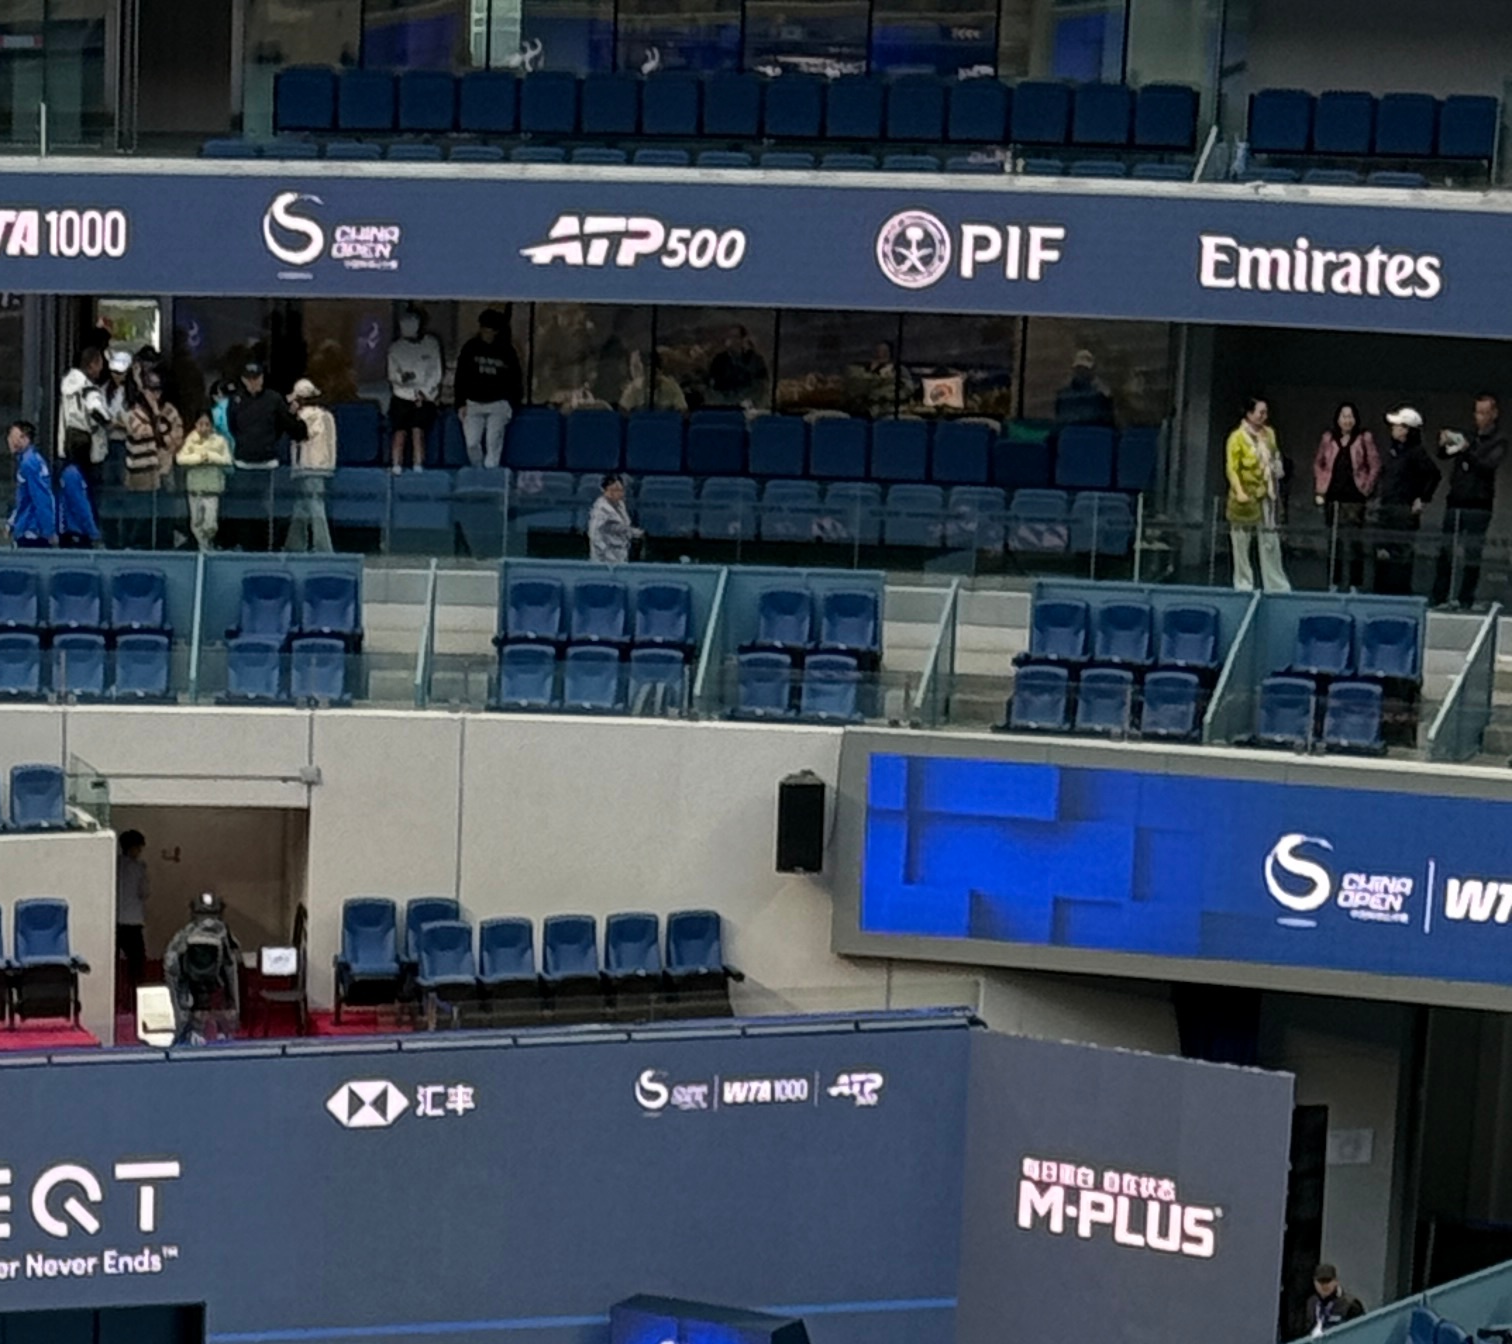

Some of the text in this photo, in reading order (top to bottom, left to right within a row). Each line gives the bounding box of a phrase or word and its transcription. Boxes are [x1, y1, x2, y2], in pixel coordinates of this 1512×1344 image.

[959, 223, 1066, 281] PIF
[1198, 233, 1443, 299] Emirates
[25, 1252, 99, 1279] Never
